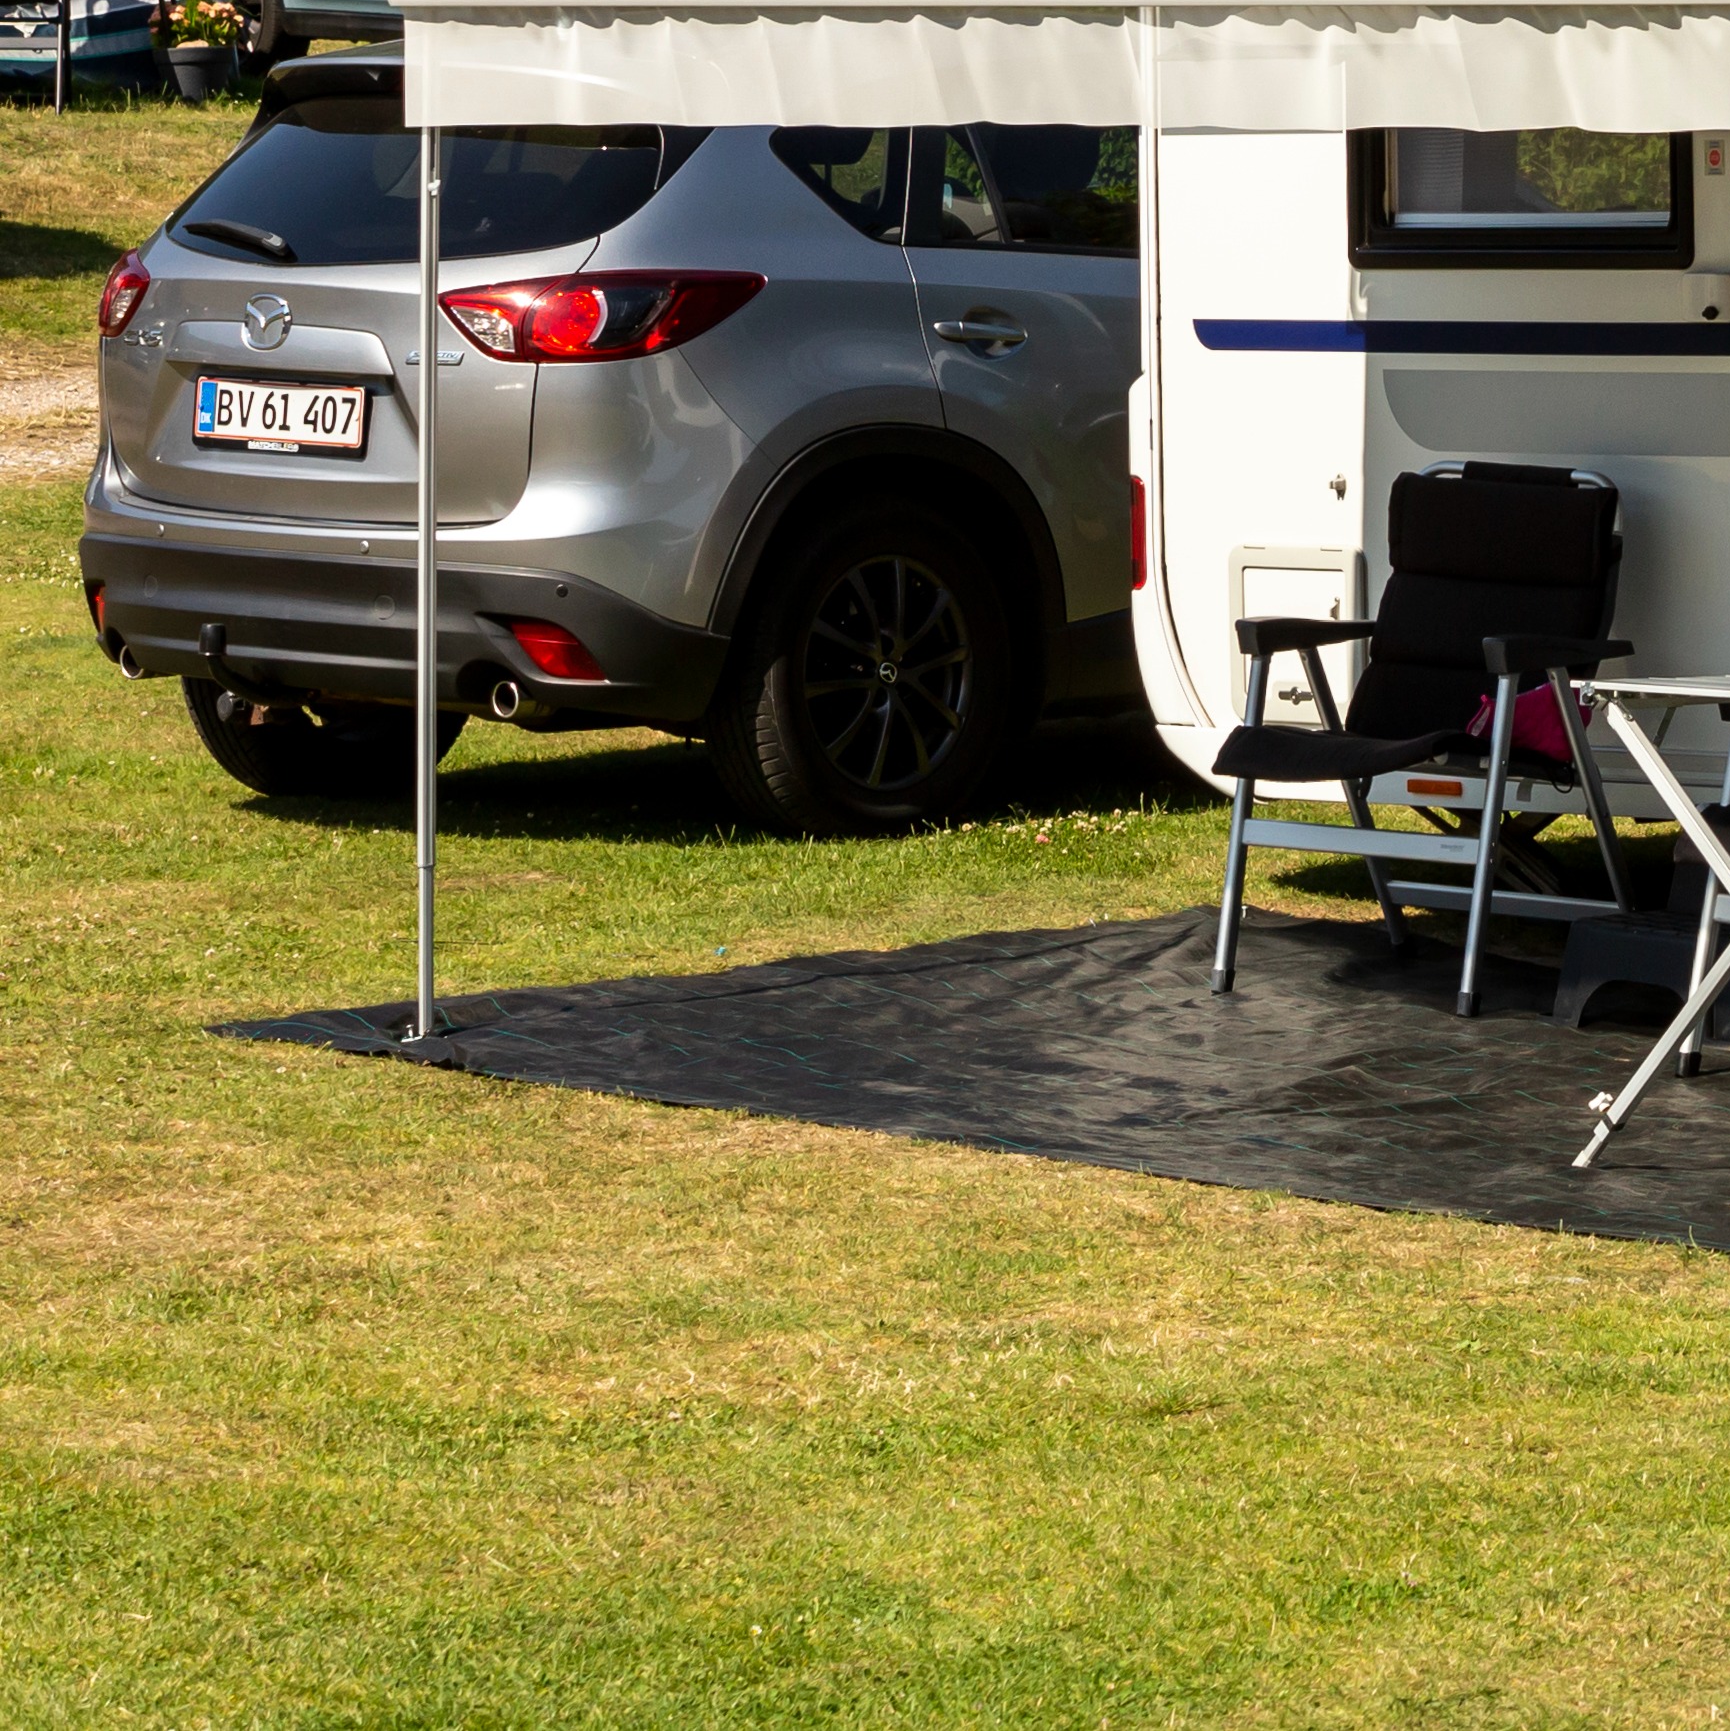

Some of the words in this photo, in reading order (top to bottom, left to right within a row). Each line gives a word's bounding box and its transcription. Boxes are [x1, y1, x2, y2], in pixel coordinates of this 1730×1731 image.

[217, 388, 255, 428] BV
[262, 390, 290, 432] 61
[303, 394, 357, 435] 407
